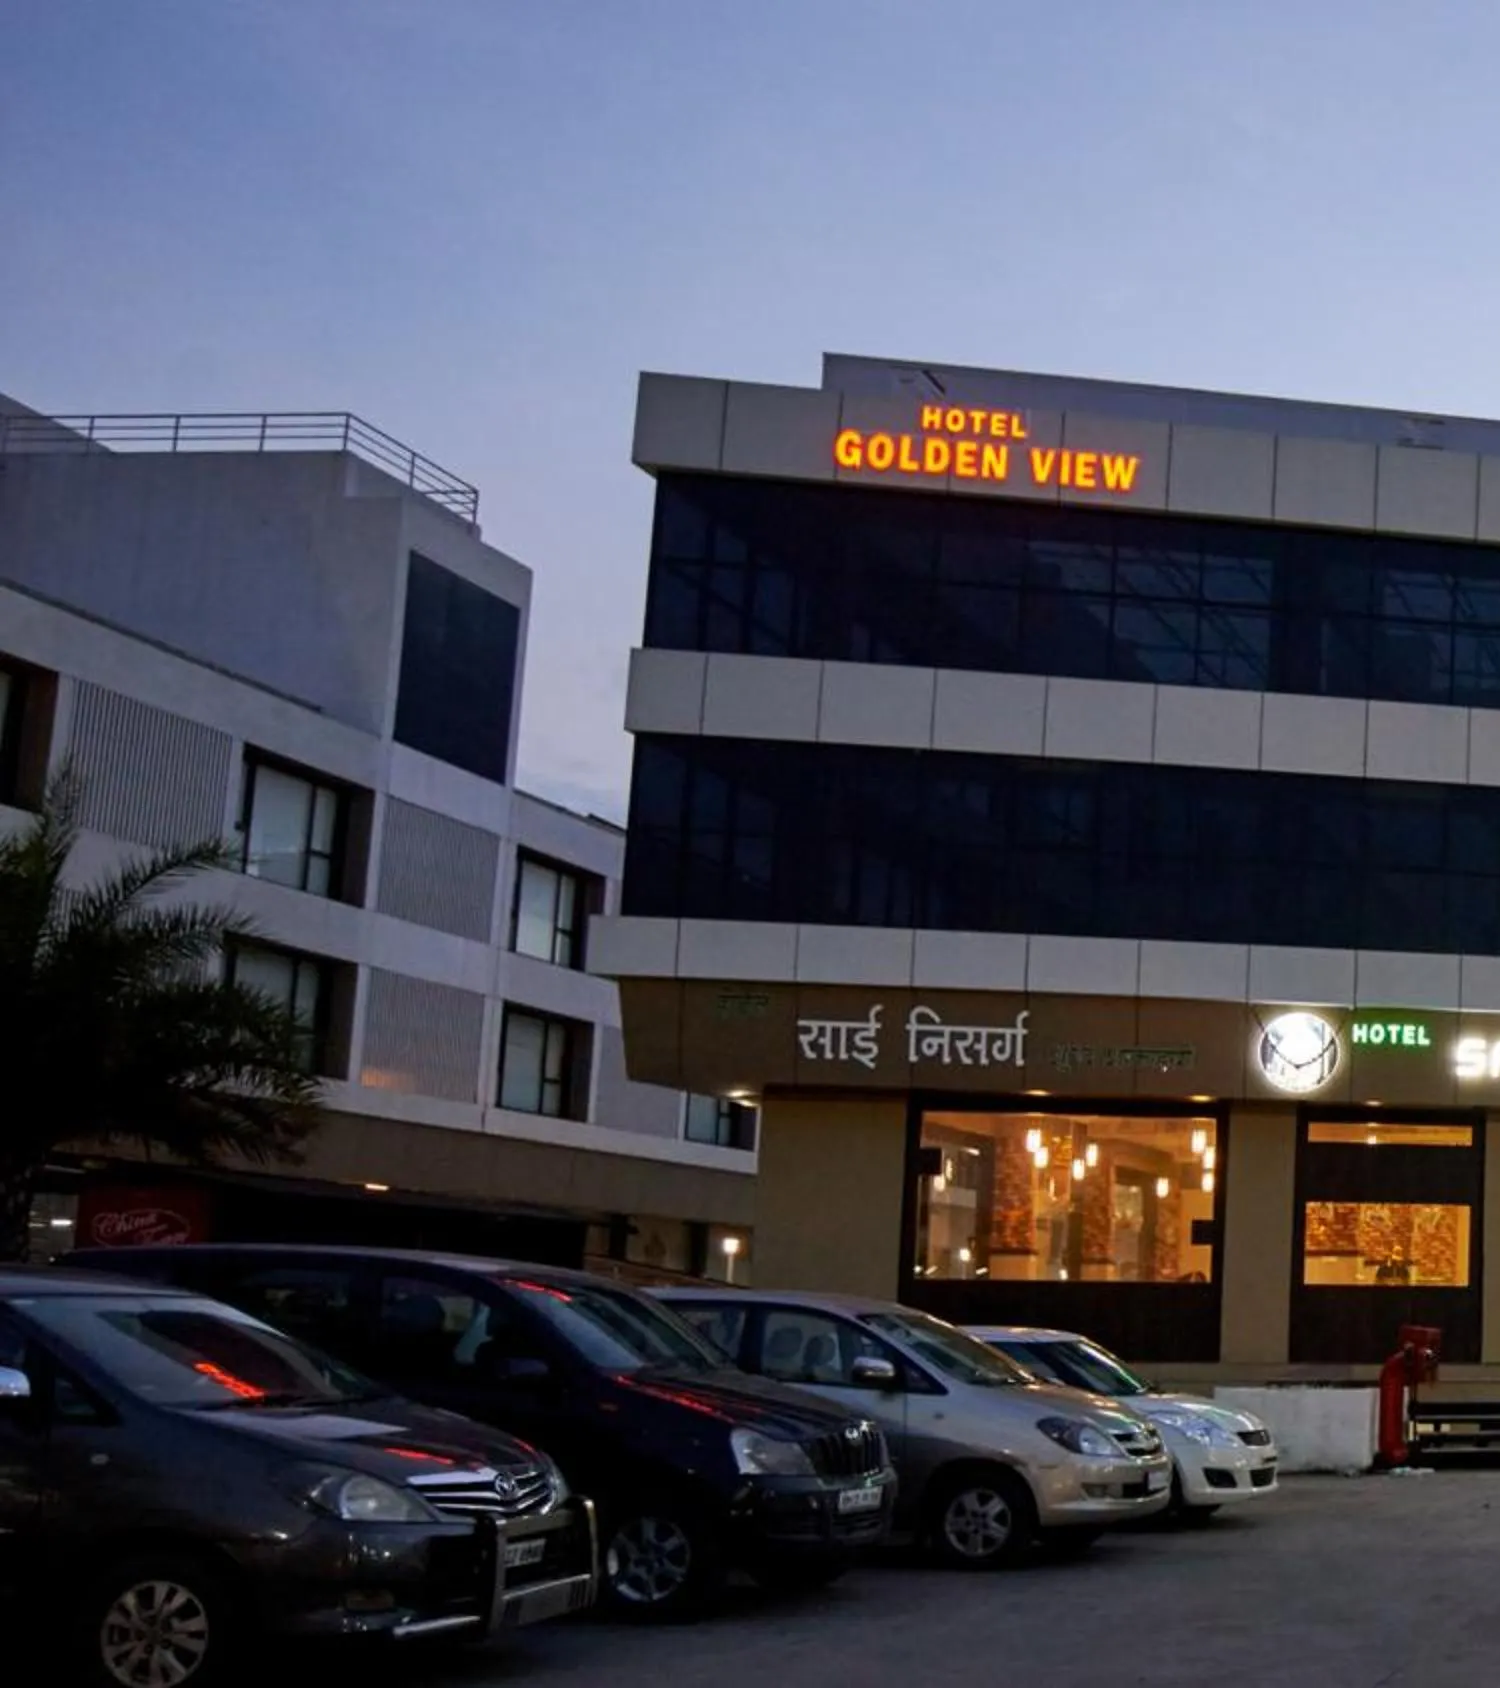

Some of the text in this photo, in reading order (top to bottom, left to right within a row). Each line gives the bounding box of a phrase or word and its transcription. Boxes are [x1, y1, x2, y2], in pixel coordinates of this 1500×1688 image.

[922, 406, 1026, 438] HOTEL
[835, 430, 1139, 490] GOLDEN VIEW
[798, 1005, 883, 1067] साई
[906, 1006, 1029, 1066] निसर्ग
[1352, 1023, 1430, 1046] HOTEL
